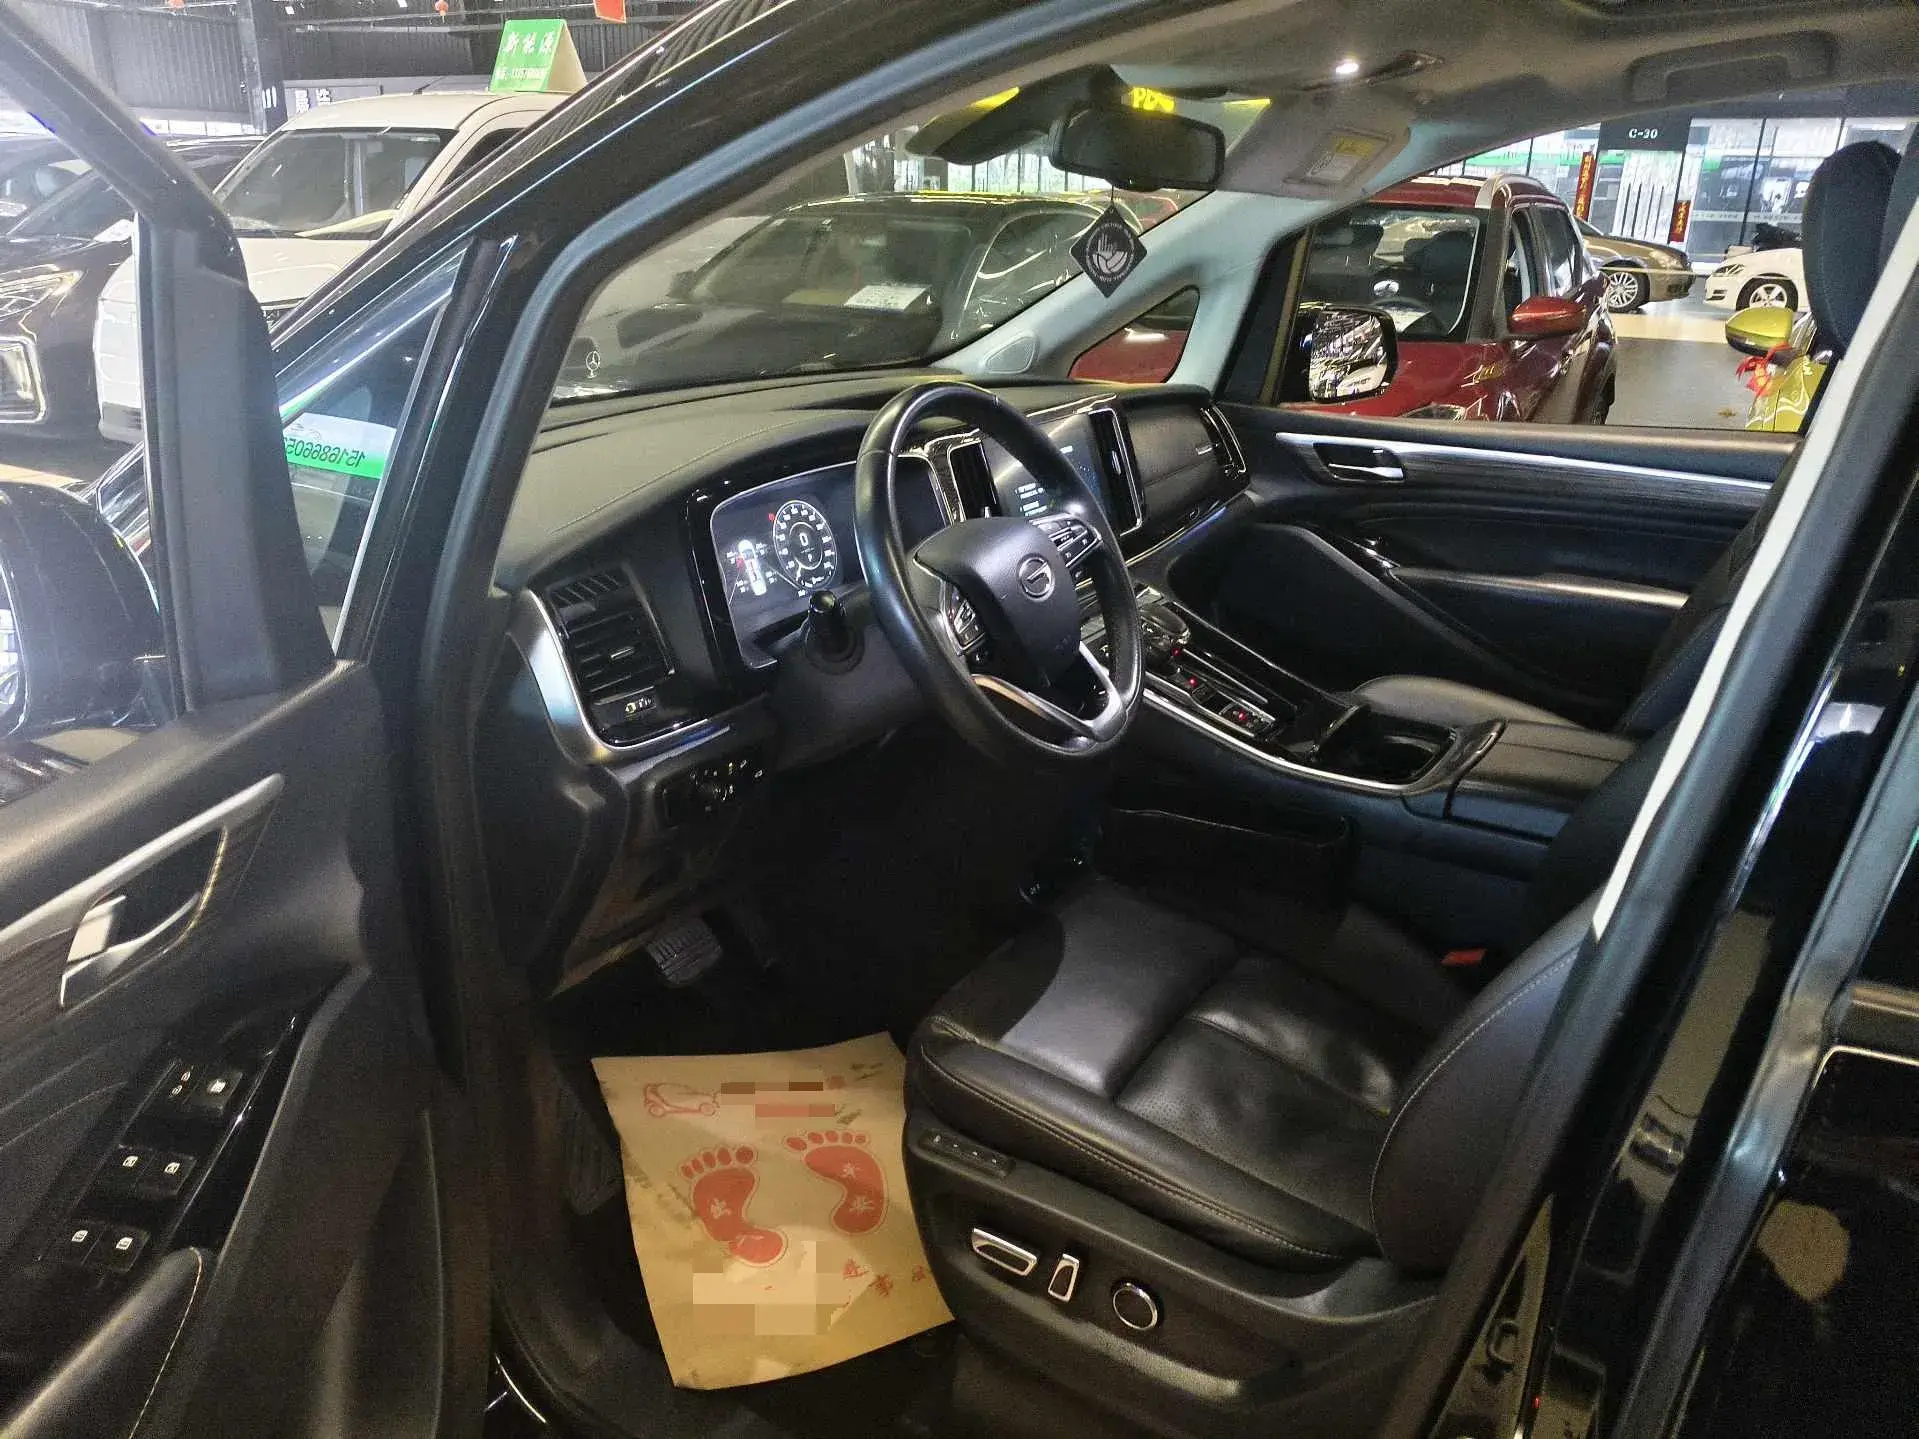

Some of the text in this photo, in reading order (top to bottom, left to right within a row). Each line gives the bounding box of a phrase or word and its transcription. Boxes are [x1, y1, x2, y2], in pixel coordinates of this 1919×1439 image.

[502, 31, 556, 56] 新能源
[1628, 128, 1659, 139] C-30
[799, 532, 809, 547] 0
